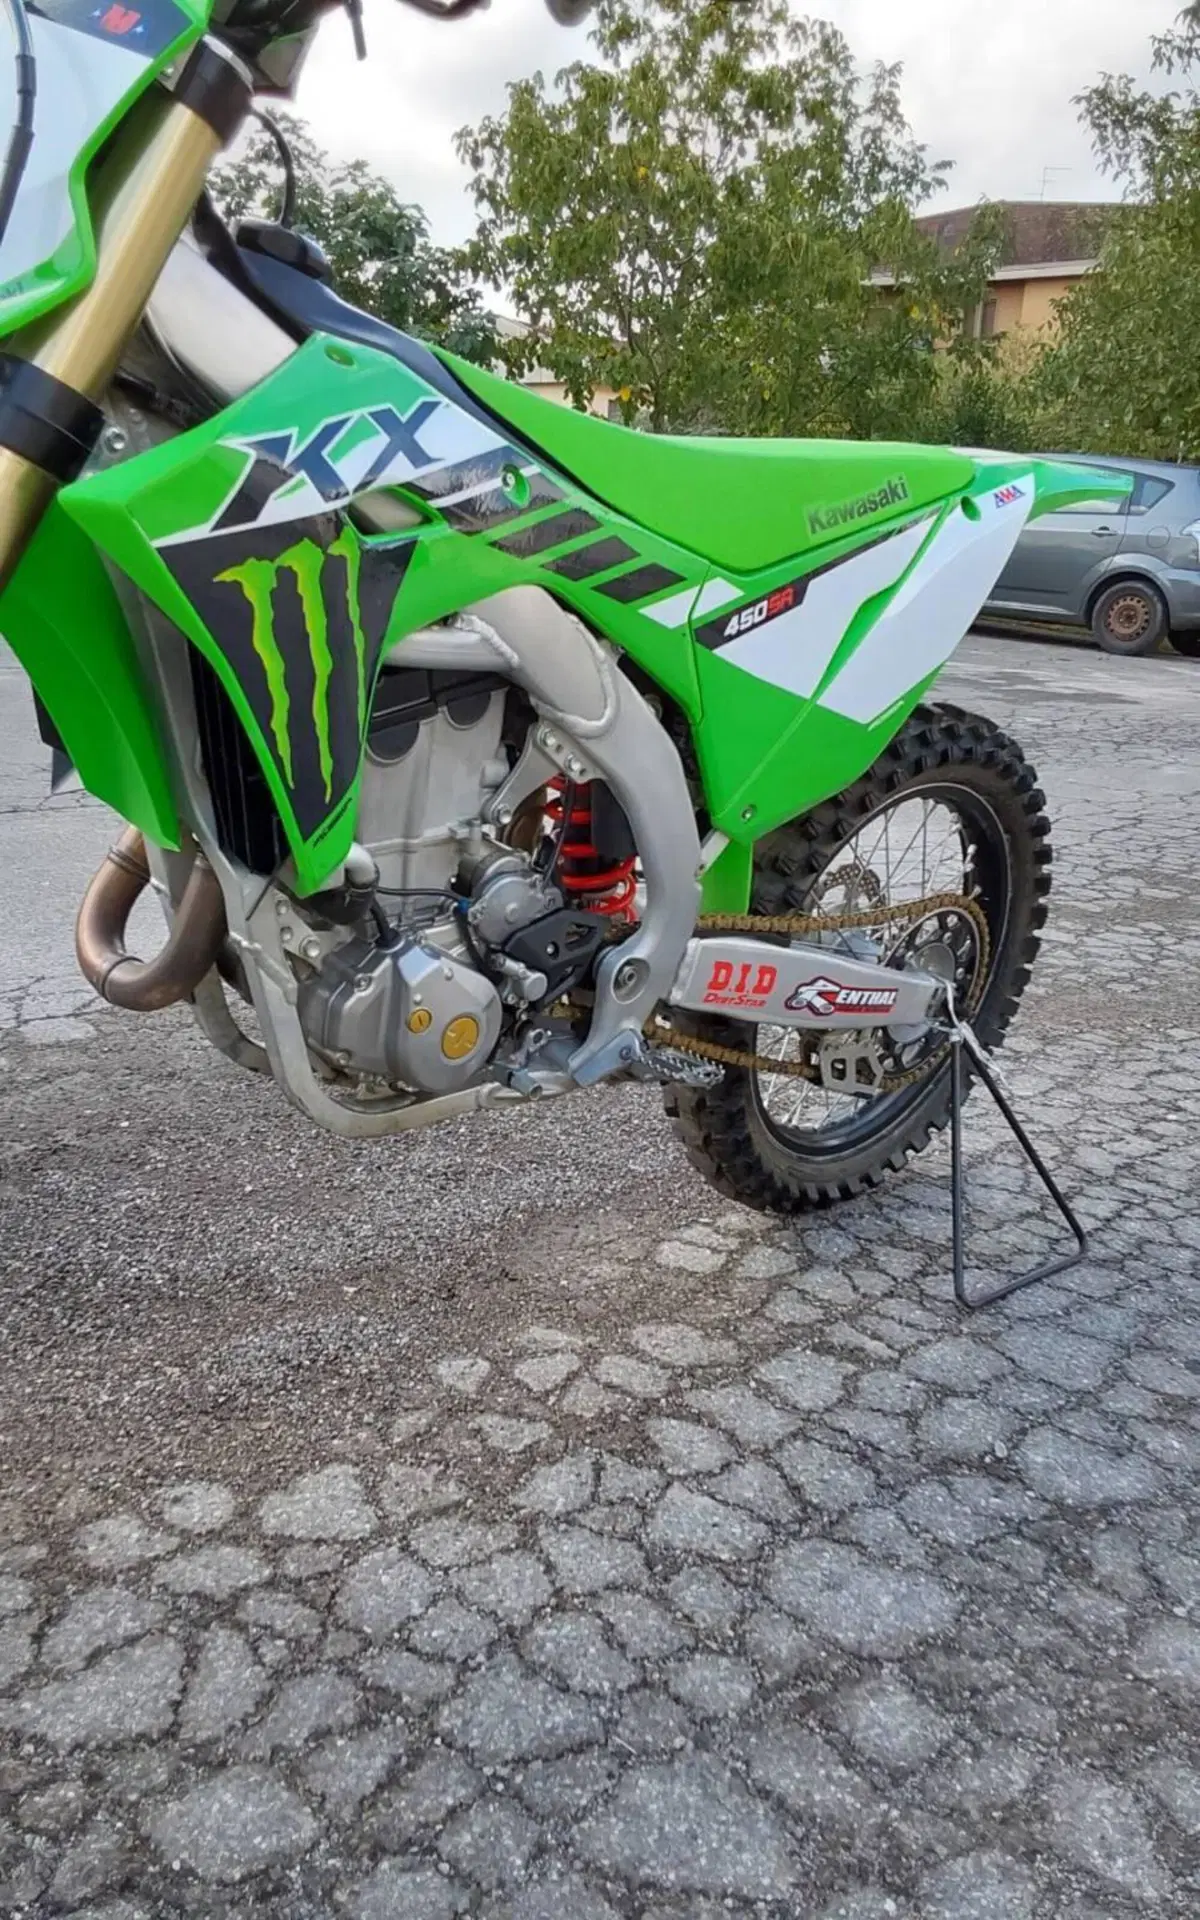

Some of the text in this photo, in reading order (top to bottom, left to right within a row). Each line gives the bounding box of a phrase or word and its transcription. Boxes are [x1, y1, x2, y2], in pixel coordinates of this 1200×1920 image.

[208, 399, 446, 533] KX
[808, 476, 909, 534] Kawasaki
[707, 960, 777, 995] D.I.D
